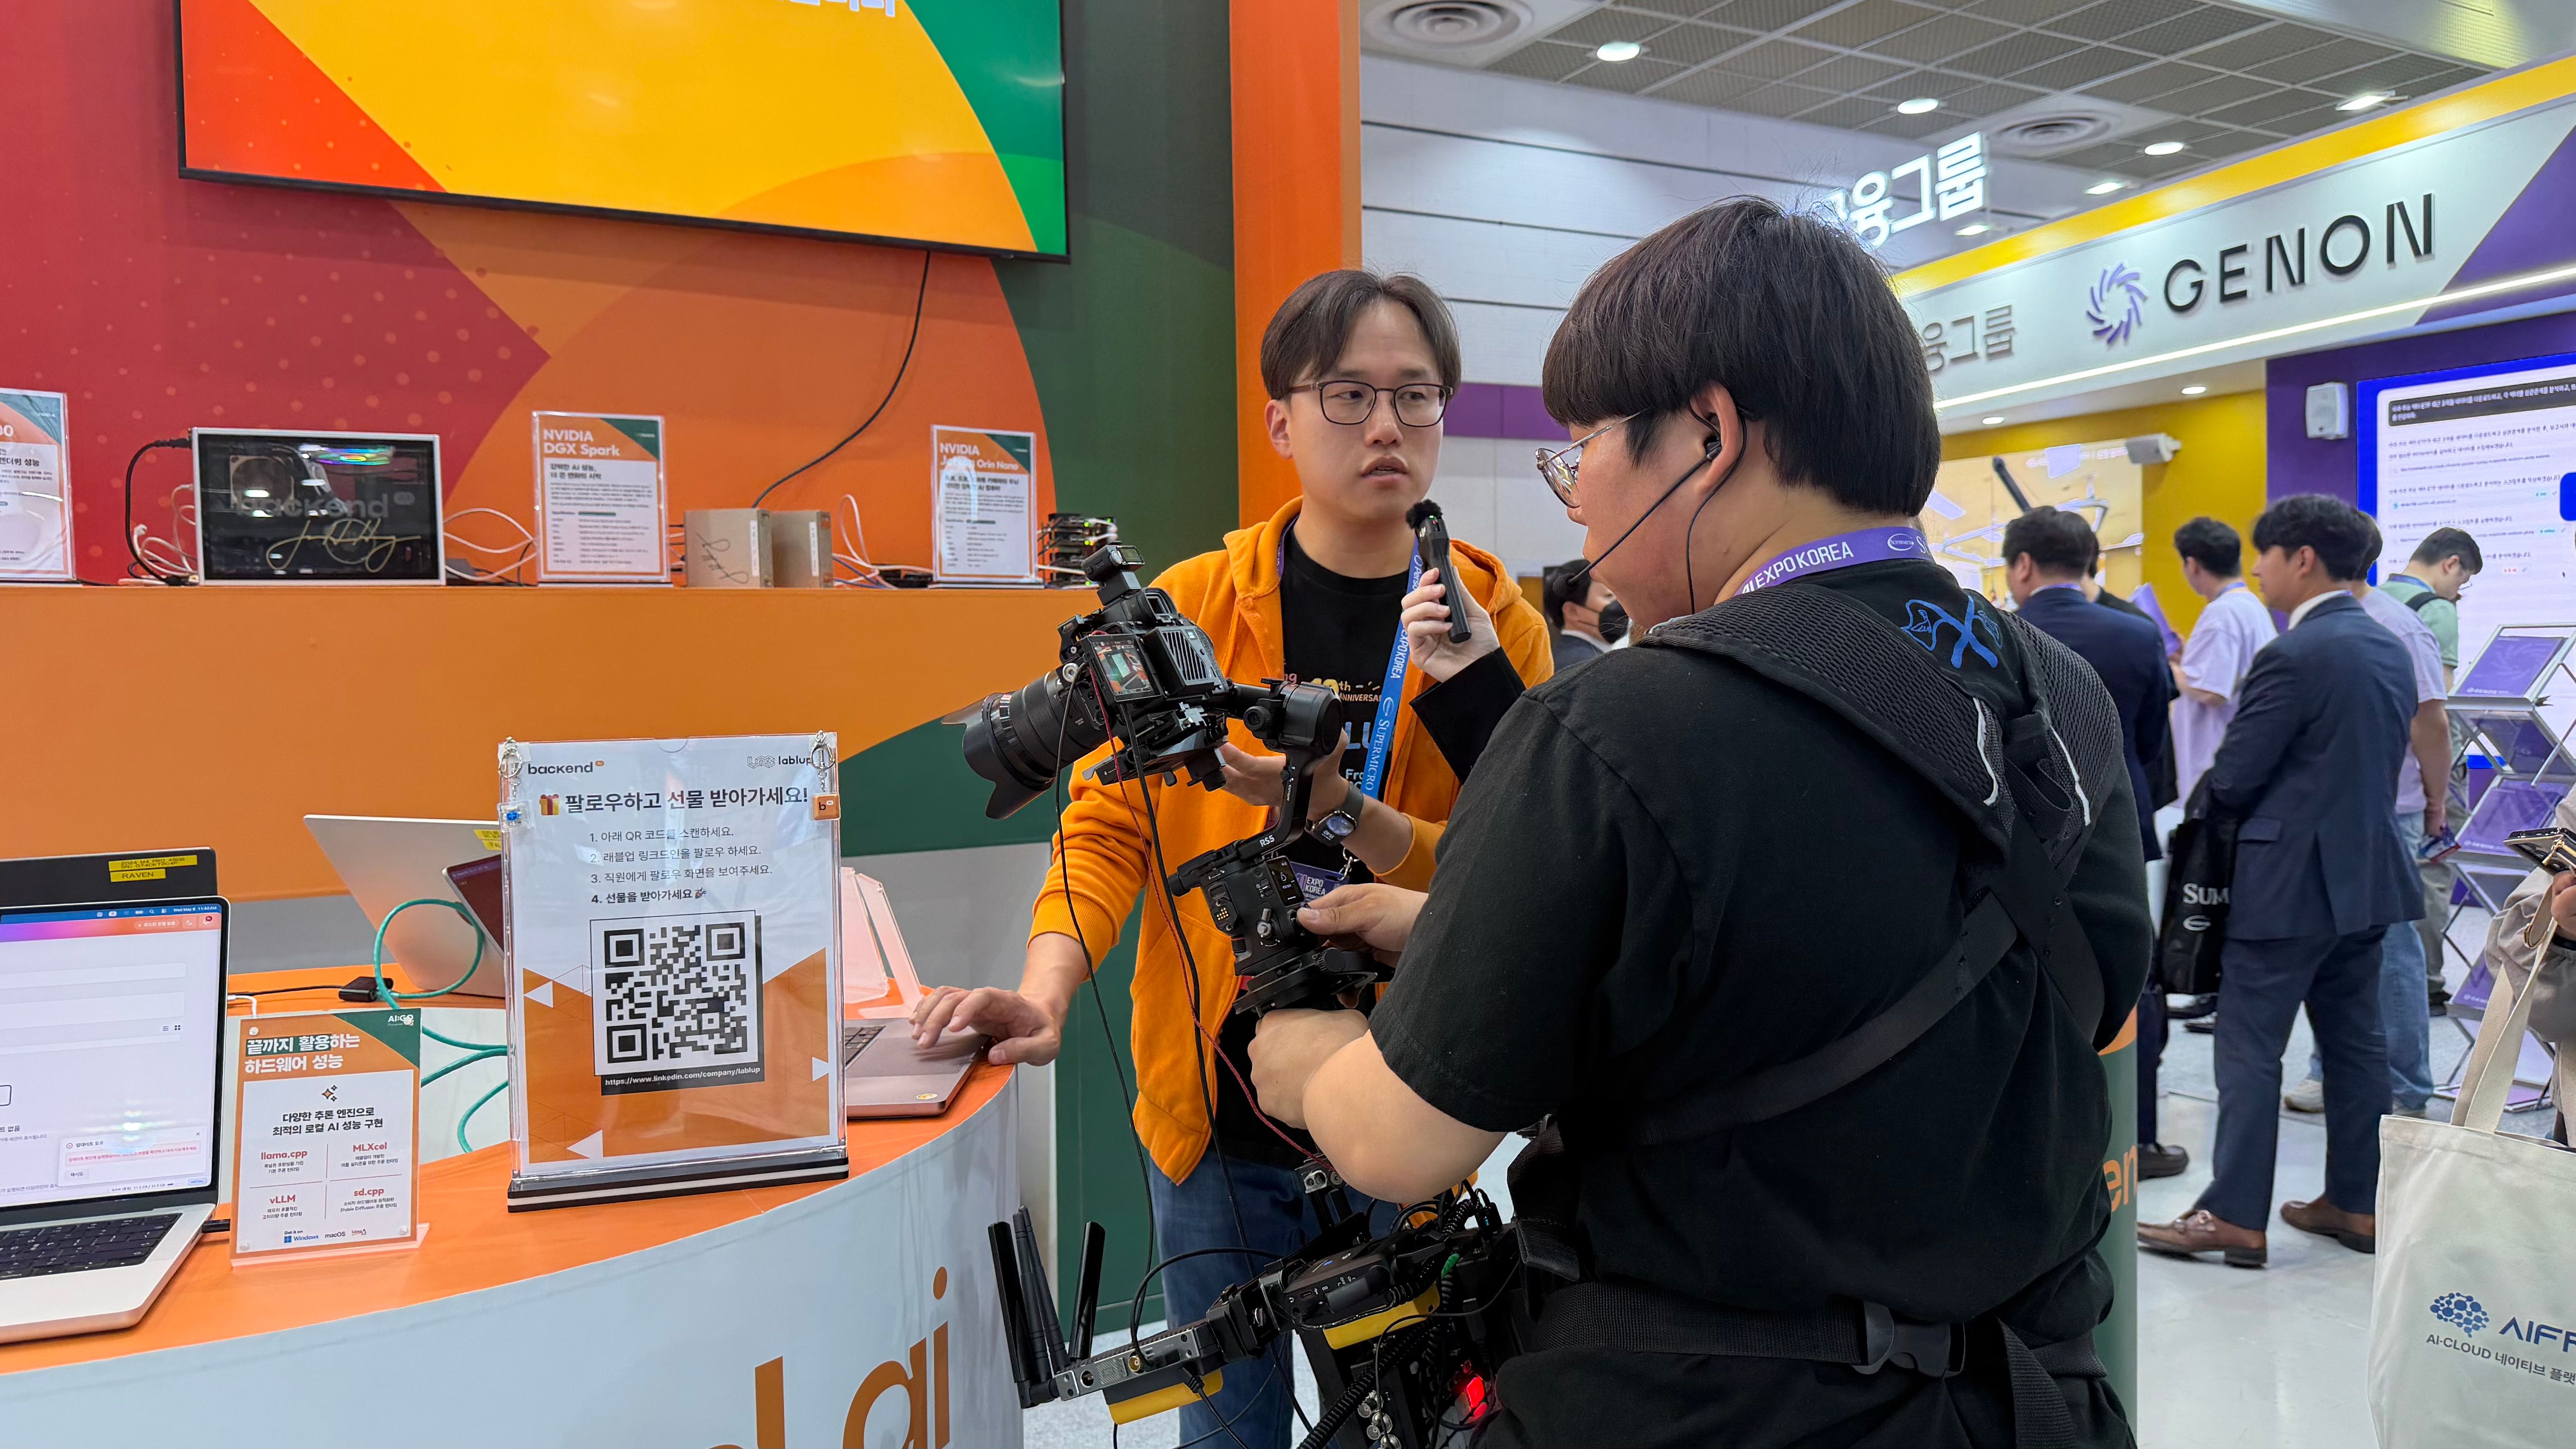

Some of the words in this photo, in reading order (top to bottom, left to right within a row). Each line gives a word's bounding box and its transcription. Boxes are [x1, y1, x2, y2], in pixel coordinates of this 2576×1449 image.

[2164, 193, 2435, 313] GENON
[1923, 304, 2014, 373] 융그룹
[543, 429, 594, 442] NVIDIA
[543, 442, 577, 455] DGX
[580, 444, 621, 457] Spark
[940, 442, 980, 456] NVIDIA
[977, 458, 995, 469] Orin
[997, 460, 1019, 470] Nano
[237, 492, 389, 518] backend
[1339, 694, 1381, 702] ANNIVERSA
[1365, 719, 1389, 791] SUPERMICRO
[528, 761, 593, 775] backend
[565, 792, 662, 814] 팔로우하고
[667, 790, 704, 810] 선물
[710, 786, 808, 808] 받아가세요!
[819, 801, 826, 811] b
[589, 833, 598, 842] 1.
[601, 831, 622, 842] 아래
[626, 831, 642, 841] QR
[645, 829, 676, 841] 코드를
[679, 826, 734, 839] 스캔하세요.
[1259, 835, 1275, 847] RS5
[590, 853, 600, 863] 2.
[603, 851, 635, 863] 래블업
[638, 848, 691, 862] 링크드인을
[693, 846, 725, 859] 팔로우
[727, 845, 762, 856] 하세요.
[590, 874, 602, 883] 3.
[604, 870, 647, 883] 직원에게
[649, 869, 681, 881] 팔로우
[684, 867, 715, 879] 화면을
[718, 865, 773, 877] 보여주세요.
[1306, 877, 1324, 887] EXPO
[591, 894, 603, 904] 4.
[605, 891, 637, 904] 선물을
[640, 888, 693, 902] 받아가세요
[1304, 883, 1326, 895] KOREA
[247, 1036, 294, 1055] 끝까지
[299, 1033, 361, 1051] 활용하는
[244, 1055, 307, 1074] 하드웨어
[312, 1054, 344, 1070] 성능
[605, 1067, 761, 1086] https://www.linkedin.com/company/lablup
[282, 1111, 312, 1123] 다양한
[314, 1109, 334, 1121] 추론
[336, 1107, 375, 1119] 엔진으로
[272, 1124, 302, 1136] 최적의
[305, 1123, 324, 1134] 로컬
[327, 1122, 339, 1132] AI
[342, 1120, 361, 1131] 성능
[364, 1118, 383, 1129] 구현
[353, 1141, 387, 1152] MLXcel
[260, 1150, 308, 1160] llama.cpp
[269, 1194, 296, 1204] vLLM
[354, 1187, 385, 1197] sd.cpp
[2495, 1351, 2546, 1376] 네이티브
